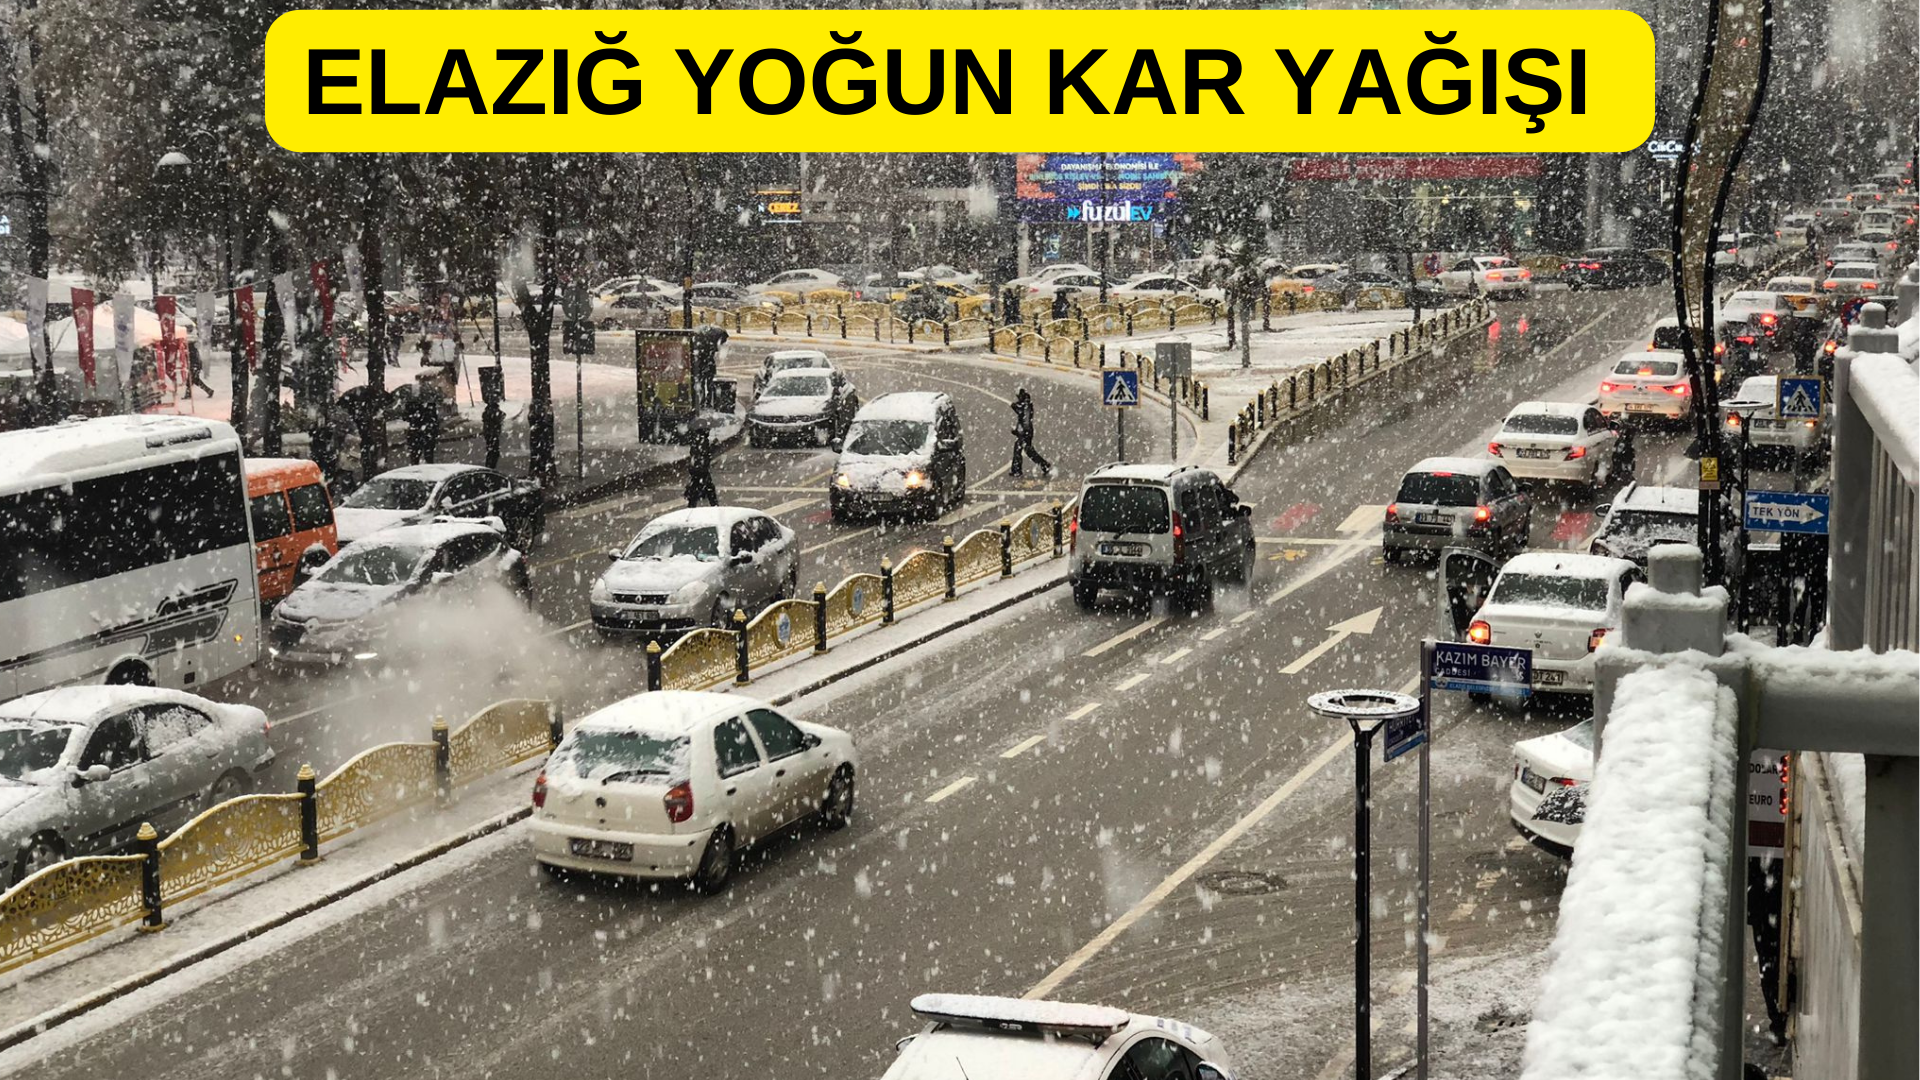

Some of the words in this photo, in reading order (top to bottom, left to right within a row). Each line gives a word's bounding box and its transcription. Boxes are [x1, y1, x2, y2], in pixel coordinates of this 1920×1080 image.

[1753, 507, 1773, 517] TEK
[1777, 506, 1800, 518] YÖN
[1436, 651, 1477, 667] KAZIM
[1481, 655, 1526, 669] BAYER
[1545, 673, 1561, 682] 241
[1749, 795, 1773, 806] EURO
